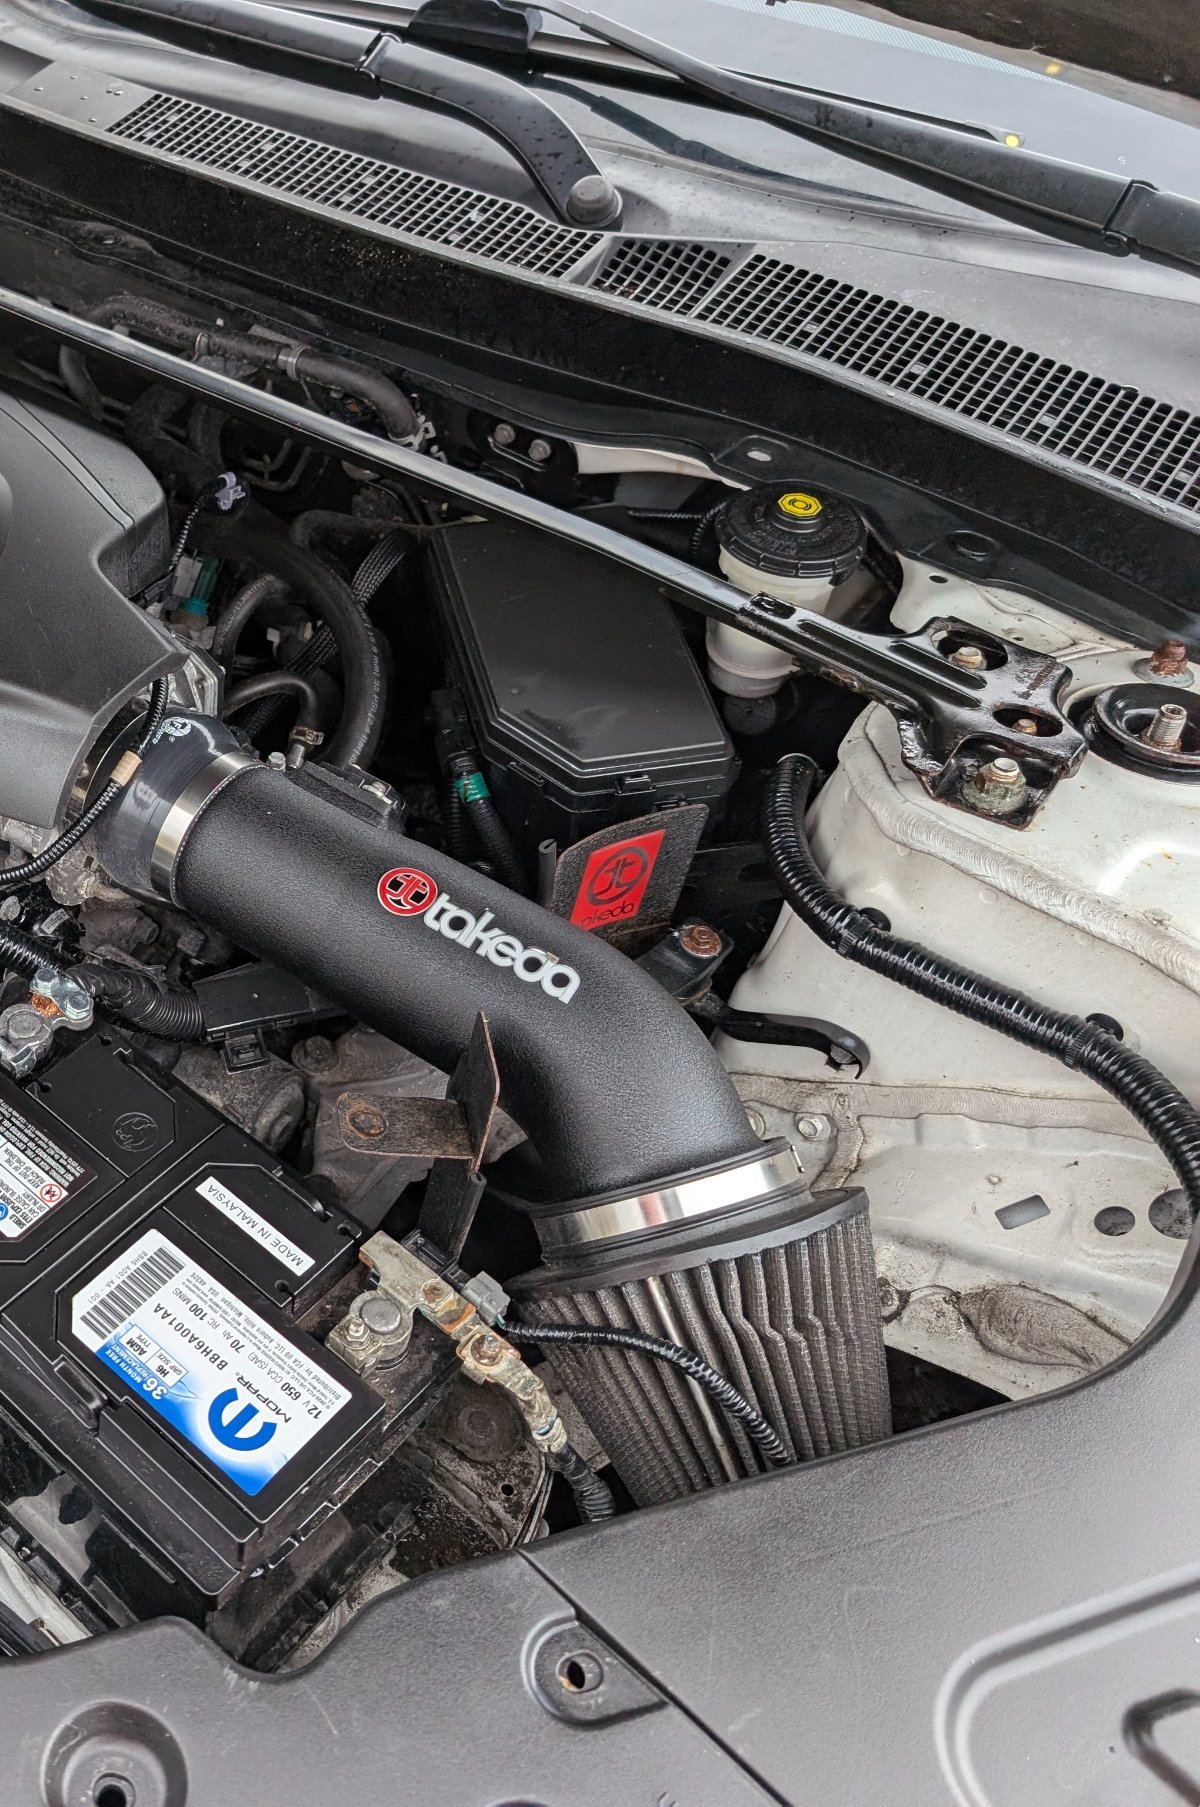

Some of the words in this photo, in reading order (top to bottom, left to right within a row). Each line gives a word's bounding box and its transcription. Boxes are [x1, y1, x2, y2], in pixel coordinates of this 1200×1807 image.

[581, 901, 634, 928] akeda
[423, 892, 580, 1003] takeda
[4, 1157, 15, 1166] THE
[12, 1164, 21, 1172] OF
[18, 1170, 30, 1179] OUT
[29, 1171, 46, 1185] REACH
[27, 1177, 41, 1189] KEEP
[0, 1193, 22, 1214] EXPLOSIVE
[14, 1195, 31, 1210] CAUSE
[37, 1204, 46, 1212] OR
[206, 1185, 259, 1229] MALAYSIA
[20, 1212, 33, 1223] EYES
[28, 1207, 40, 1217] CAN
[8, 1213, 27, 1230] SHIELD
[257, 1227, 272, 1239] IN
[130, 1250, 148, 1266] BBH6
[270, 1238, 304, 1266] MADE
[115, 1265, 132, 1280] A001
[105, 1279, 116, 1289] AA
[87, 1292, 101, 1305] 001
[172, 1287, 192, 1305] MINS
[207, 1287, 219, 1297] USA
[188, 1303, 209, 1321] 100
[220, 1296, 244, 1317] Michigan
[207, 1318, 220, 1330] RC
[136, 1334, 151, 1347] TYPE
[152, 1303, 228, 1370] BBH6A001AA
[221, 1330, 233, 1341] Ah
[255, 1327, 275, 1344] Auburn
[126, 1338, 147, 1357] AGM
[229, 1338, 245, 1353] 70
[104, 1348, 121, 1364] FREE
[110, 1343, 149, 1378] REPLACEMENT
[157, 1353, 171, 1365] SIZE
[247, 1351, 269, 1371] (SAE)
[284, 1351, 293, 1360] US
[155, 1364, 170, 1378] H6
[169, 1364, 182, 1376] GRP
[292, 1358, 304, 1369] FCA
[119, 1361, 143, 1383] MONTH
[266, 1368, 284, 1384] CCA
[142, 1376, 169, 1402] 36
[280, 1381, 302, 1401] 650
[311, 1374, 341, 1400] Distributed
[236, 1375, 292, 1423] MOPAR
[302, 1399, 311, 1408] V
[307, 1405, 324, 1420] 12
